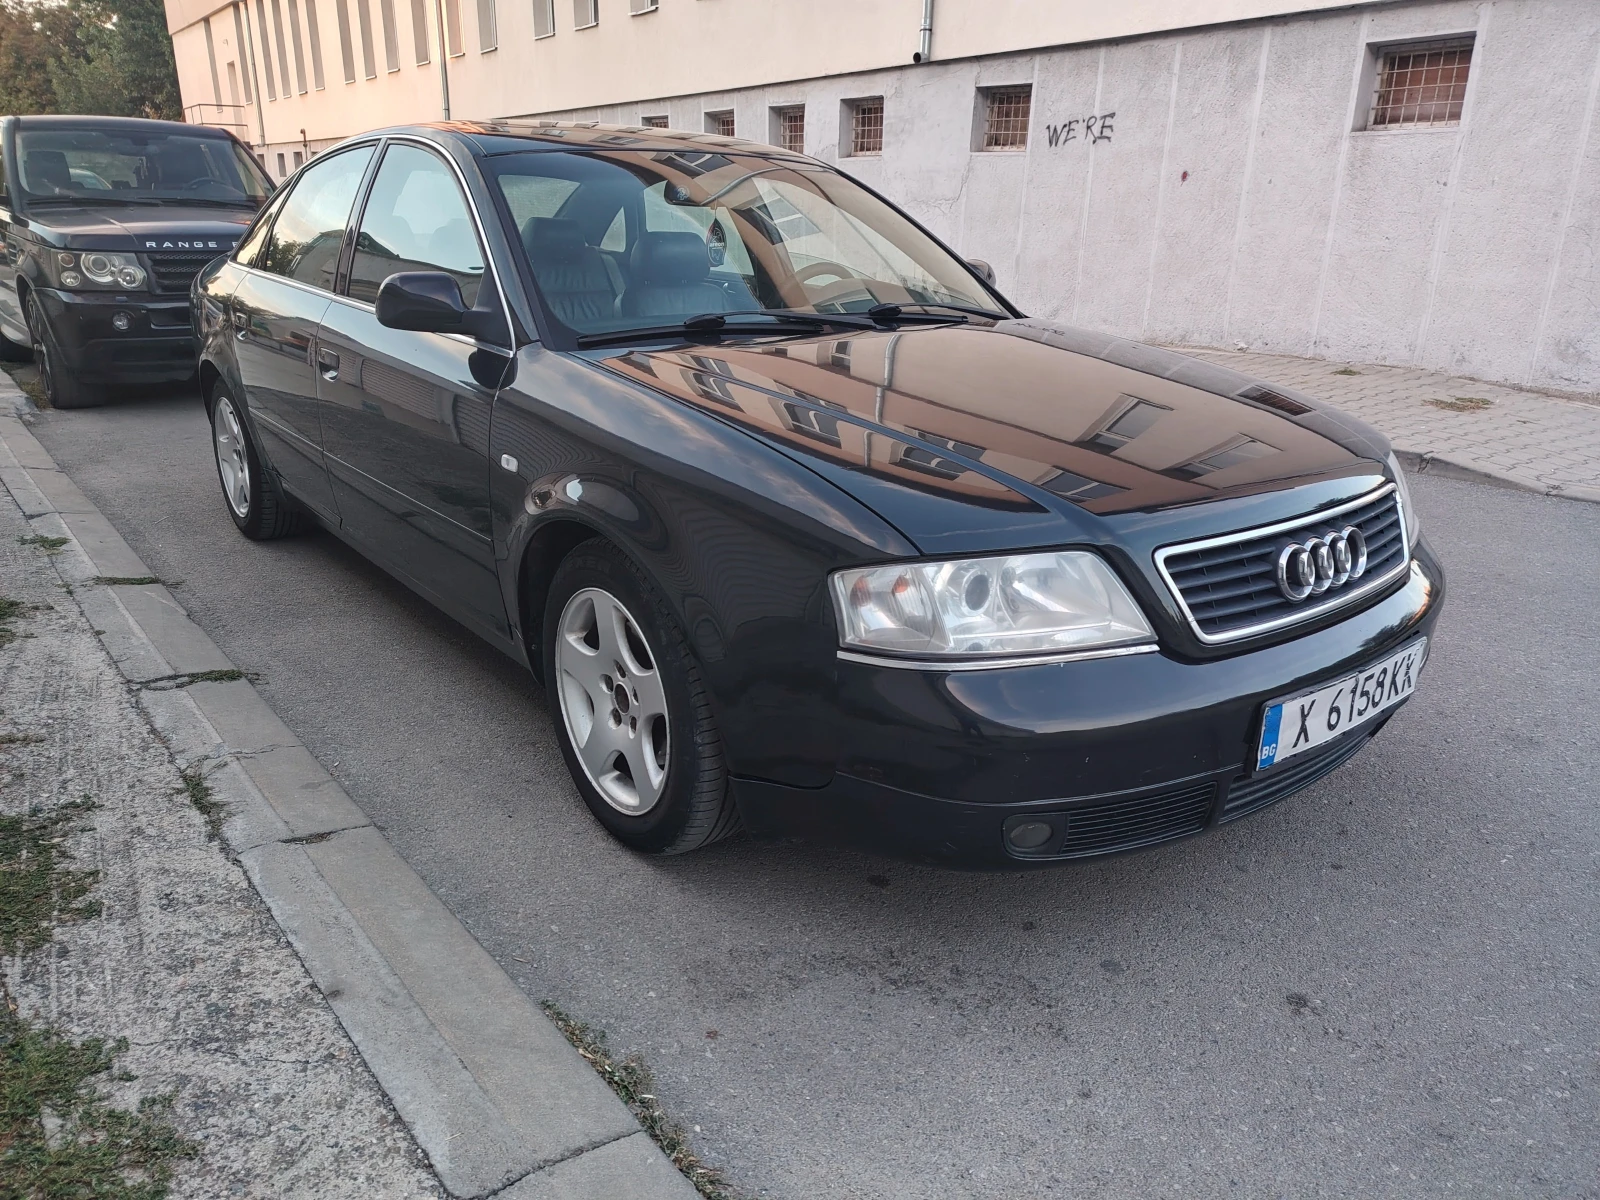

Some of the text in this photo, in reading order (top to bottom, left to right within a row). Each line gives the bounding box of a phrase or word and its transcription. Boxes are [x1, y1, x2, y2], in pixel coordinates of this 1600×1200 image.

[1046, 112, 1116, 148] WE'RE
[1292, 699, 1316, 749] X
[1261, 743, 1277, 760] BG
